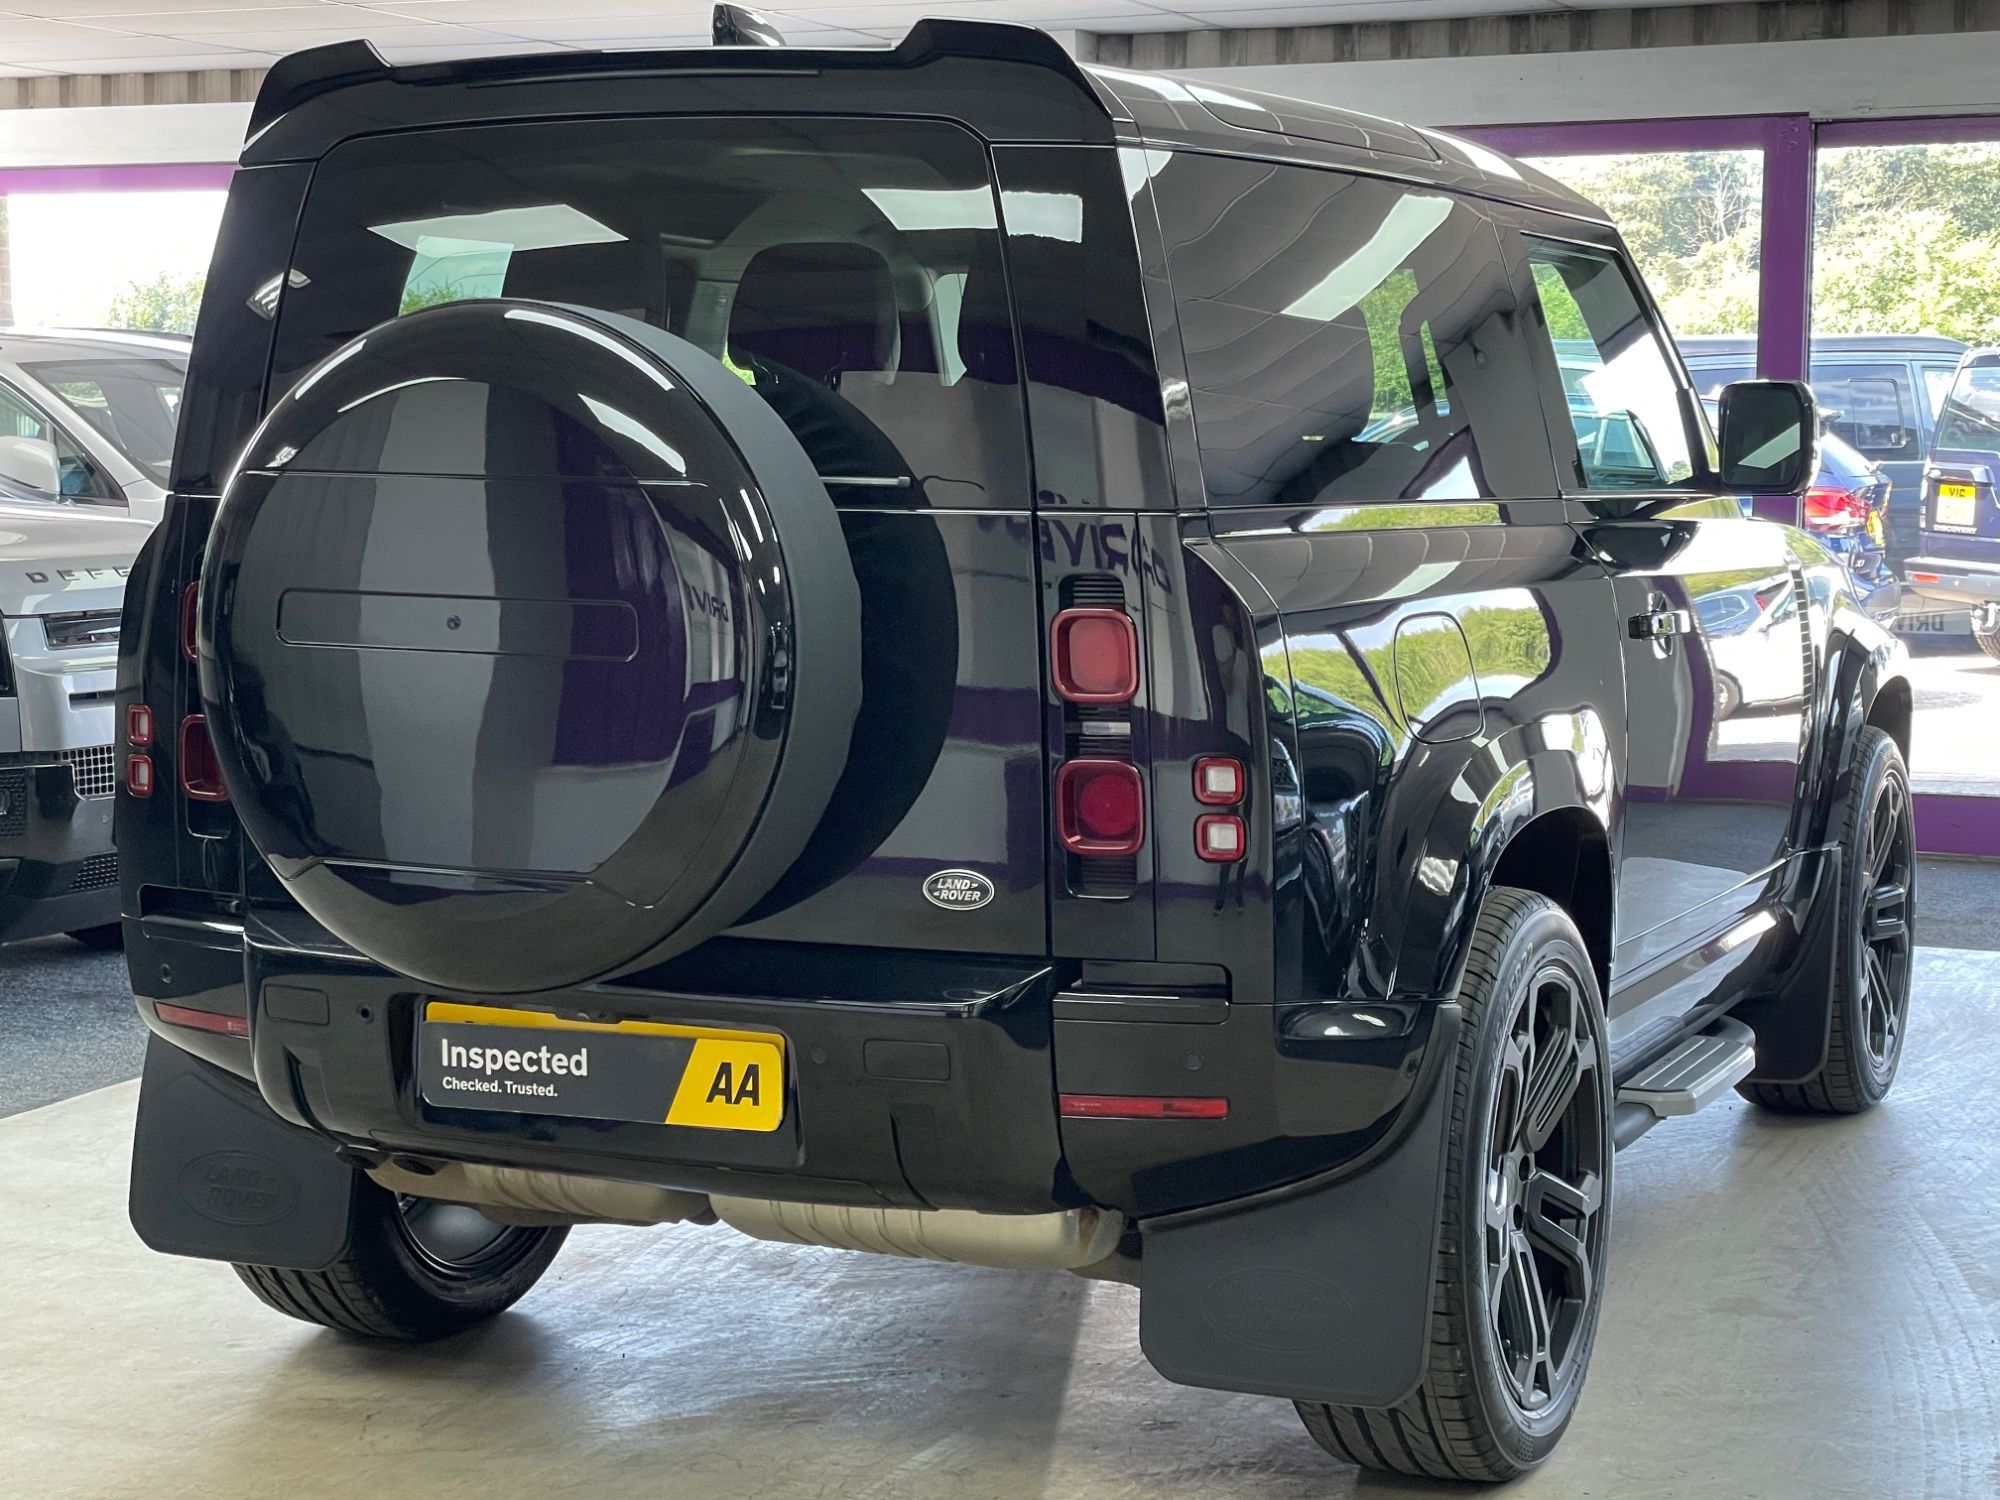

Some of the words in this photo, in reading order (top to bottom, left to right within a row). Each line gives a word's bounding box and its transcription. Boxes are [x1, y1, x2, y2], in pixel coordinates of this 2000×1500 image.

[938, 878, 970, 890] LAND
[940, 890, 981, 902] ROVER
[441, 1038, 588, 1077] Inspected
[442, 1076, 502, 1094] Checked.
[504, 1080, 558, 1098] Trusted.
[705, 1061, 760, 1107] AA
